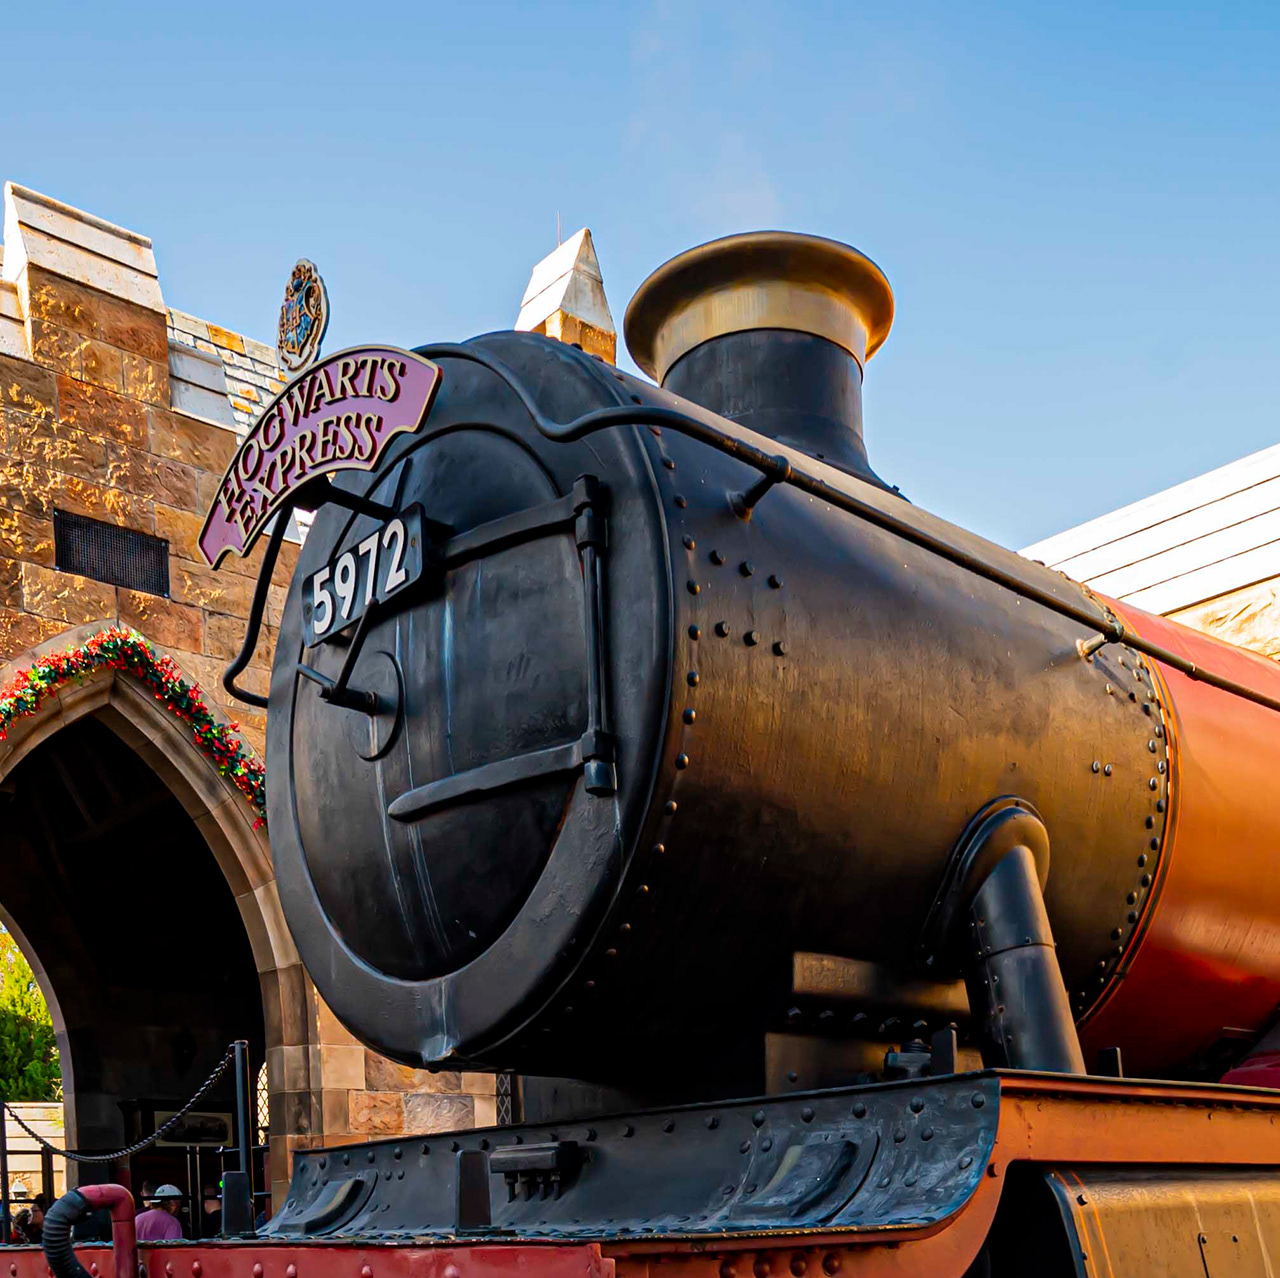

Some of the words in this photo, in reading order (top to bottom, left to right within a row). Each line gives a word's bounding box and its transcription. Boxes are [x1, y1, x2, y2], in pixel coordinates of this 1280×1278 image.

[218, 356, 407, 524] HOGWARTS
[233, 411, 383, 543] EXPRESS
[313, 518, 407, 635] 5972
